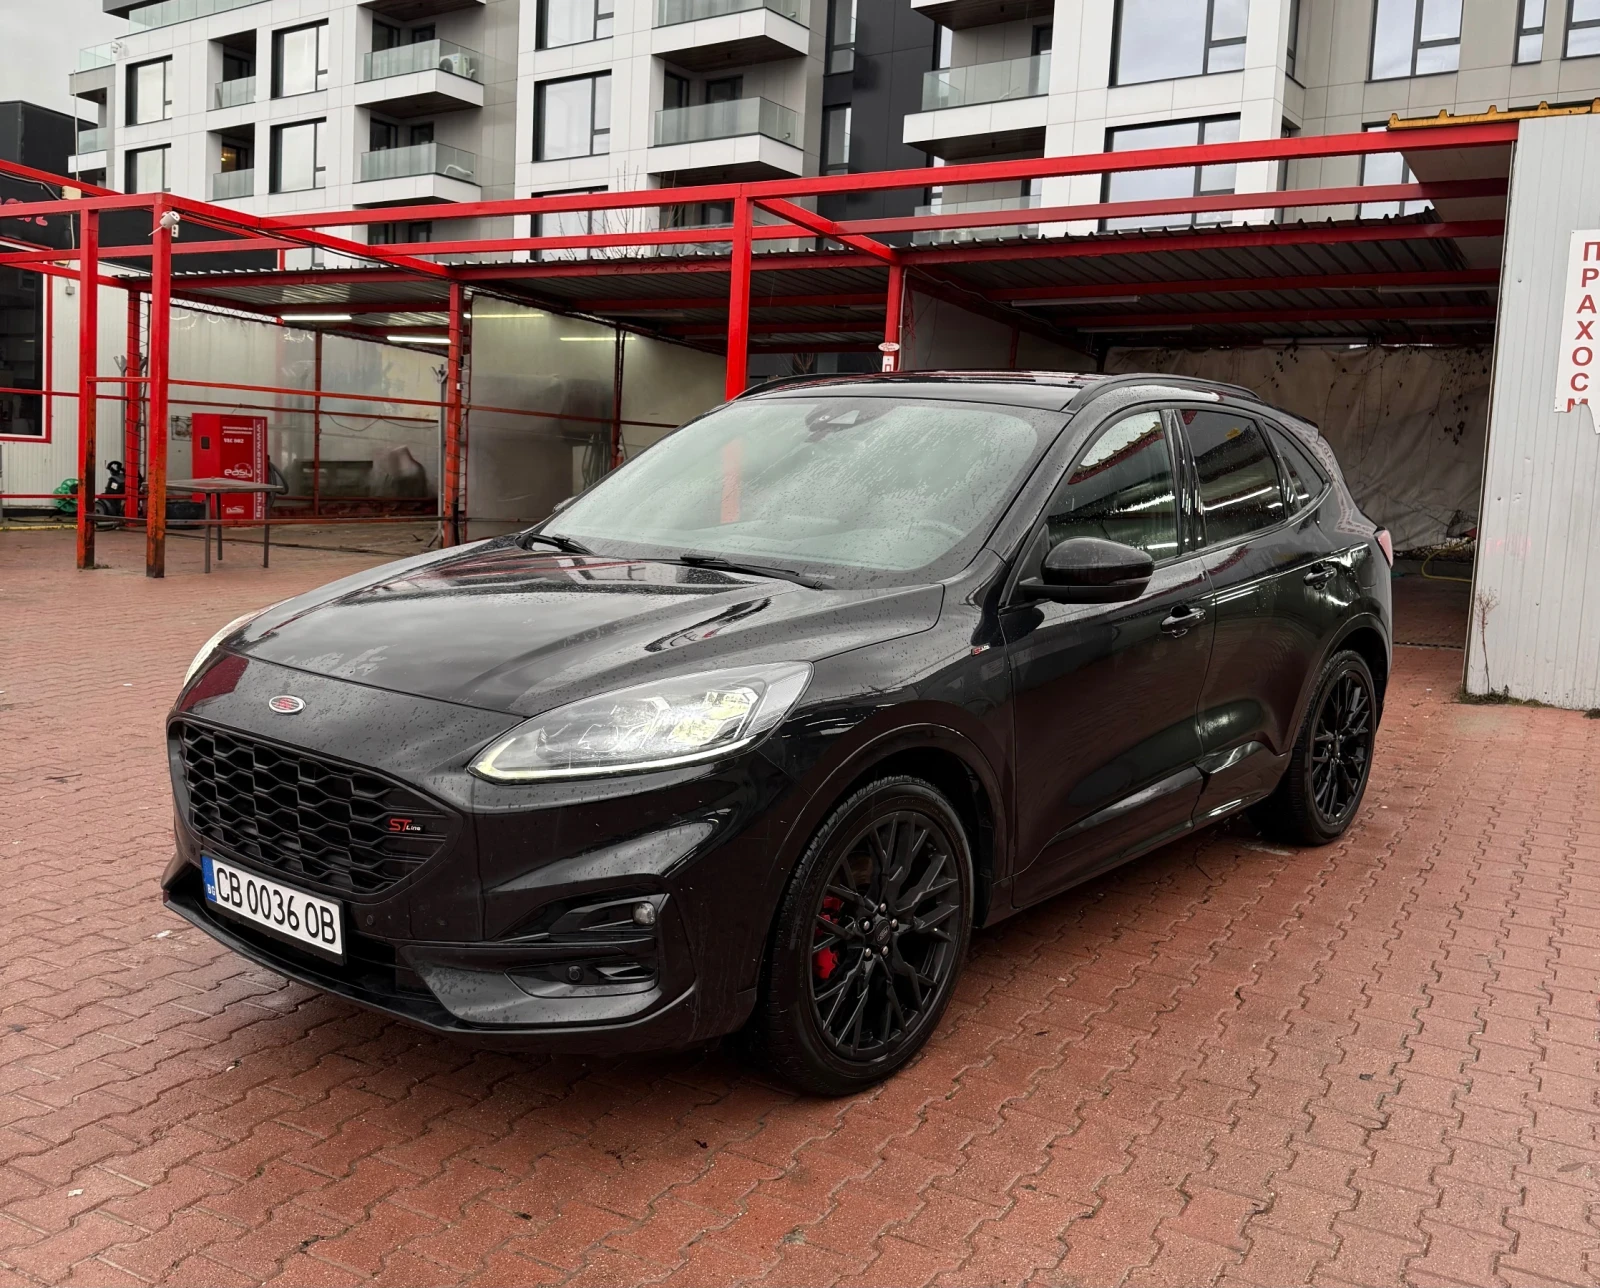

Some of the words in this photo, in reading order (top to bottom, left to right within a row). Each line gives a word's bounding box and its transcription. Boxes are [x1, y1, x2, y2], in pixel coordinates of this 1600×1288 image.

[224, 468, 252, 478] easy
[207, 883, 216, 896] BG
[216, 867, 243, 908] CB
[247, 880, 300, 931] 0036
